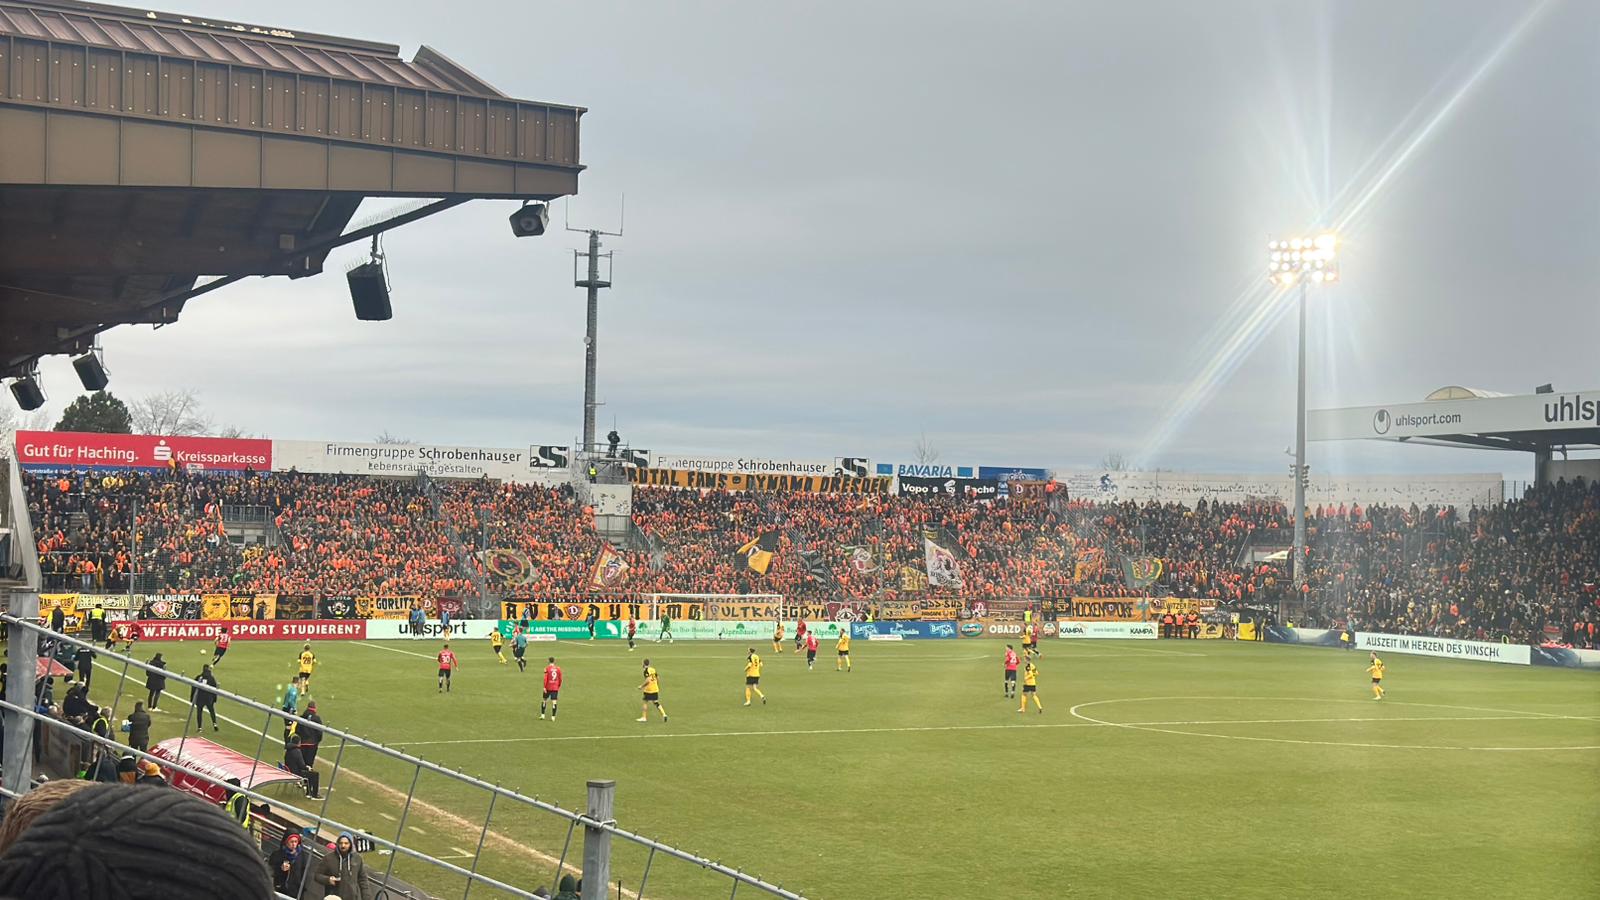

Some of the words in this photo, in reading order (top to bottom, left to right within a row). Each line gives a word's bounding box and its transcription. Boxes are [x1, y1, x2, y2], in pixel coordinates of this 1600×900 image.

[1395, 412, 1462, 428] uhlsport.com
[23, 443, 50, 458] Gut
[53, 444, 74, 458] für
[77, 446, 140, 463] Haching.
[176, 450, 266, 465] Kreissparkasse
[326, 444, 415, 459] Firmengruppe
[418, 447, 522, 463] Schrobenhauser
[437, 463, 483, 474] gestalten
[737, 458, 826, 473] Schrobenhauser
[899, 464, 952, 478] BAVARIA
[687, 470, 728, 488] FANS
[745, 474, 814, 492] DYNAMO
[820, 476, 890, 494] DRESDEN
[145, 594, 202, 602] MULDENTAL
[119, 625, 222, 637] WW.FHAM.DE
[232, 624, 274, 635] SPORT
[282, 624, 361, 635] STUDIEREN?
[1060, 626, 1084, 634] KAMPA
[1130, 627, 1153, 635] KAMPA
[1366, 636, 1398, 649] AUSZEIT
[1400, 639, 1410, 649] IM
[1411, 640, 1445, 652] HERZEN
[1446, 643, 1462, 654] DES
[441, 655, 451, 663] 30
[551, 671, 558, 681] 9
